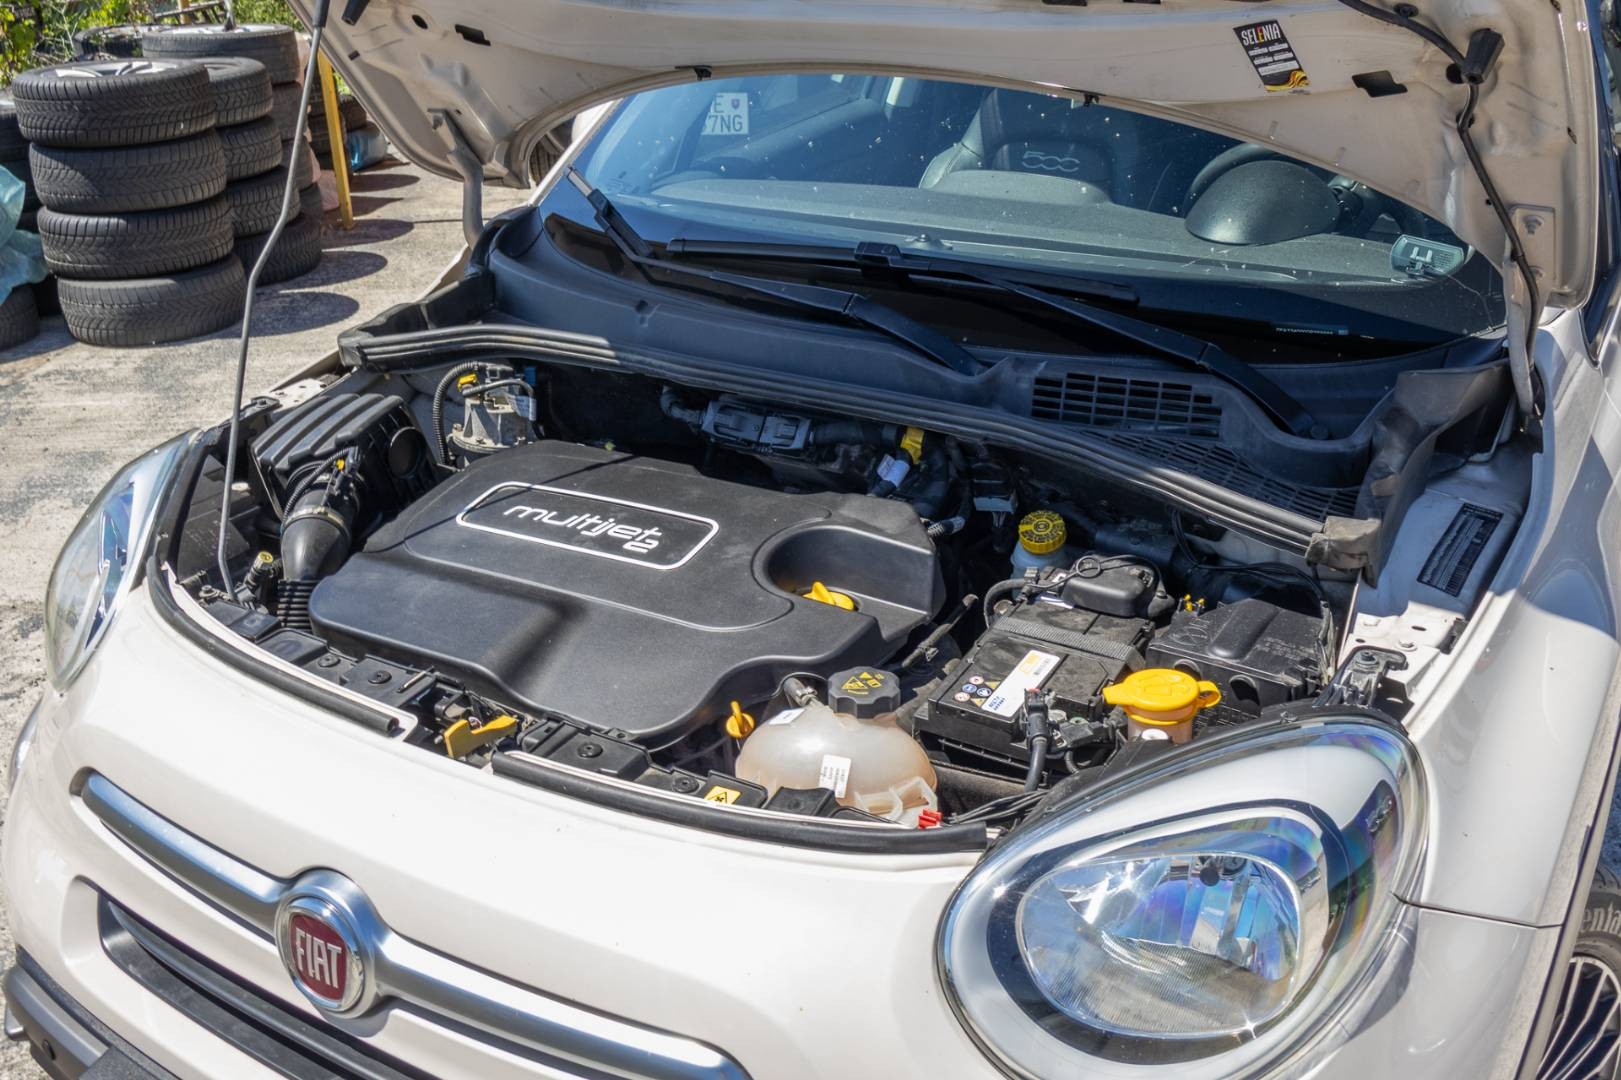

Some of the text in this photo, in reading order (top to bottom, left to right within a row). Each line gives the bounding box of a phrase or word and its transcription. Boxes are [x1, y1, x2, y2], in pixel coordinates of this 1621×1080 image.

[1241, 23, 1281, 46] SELENIA
[703, 114, 743, 133] 7NG
[503, 505, 663, 538] multijet
[295, 927, 343, 989] FIAT
